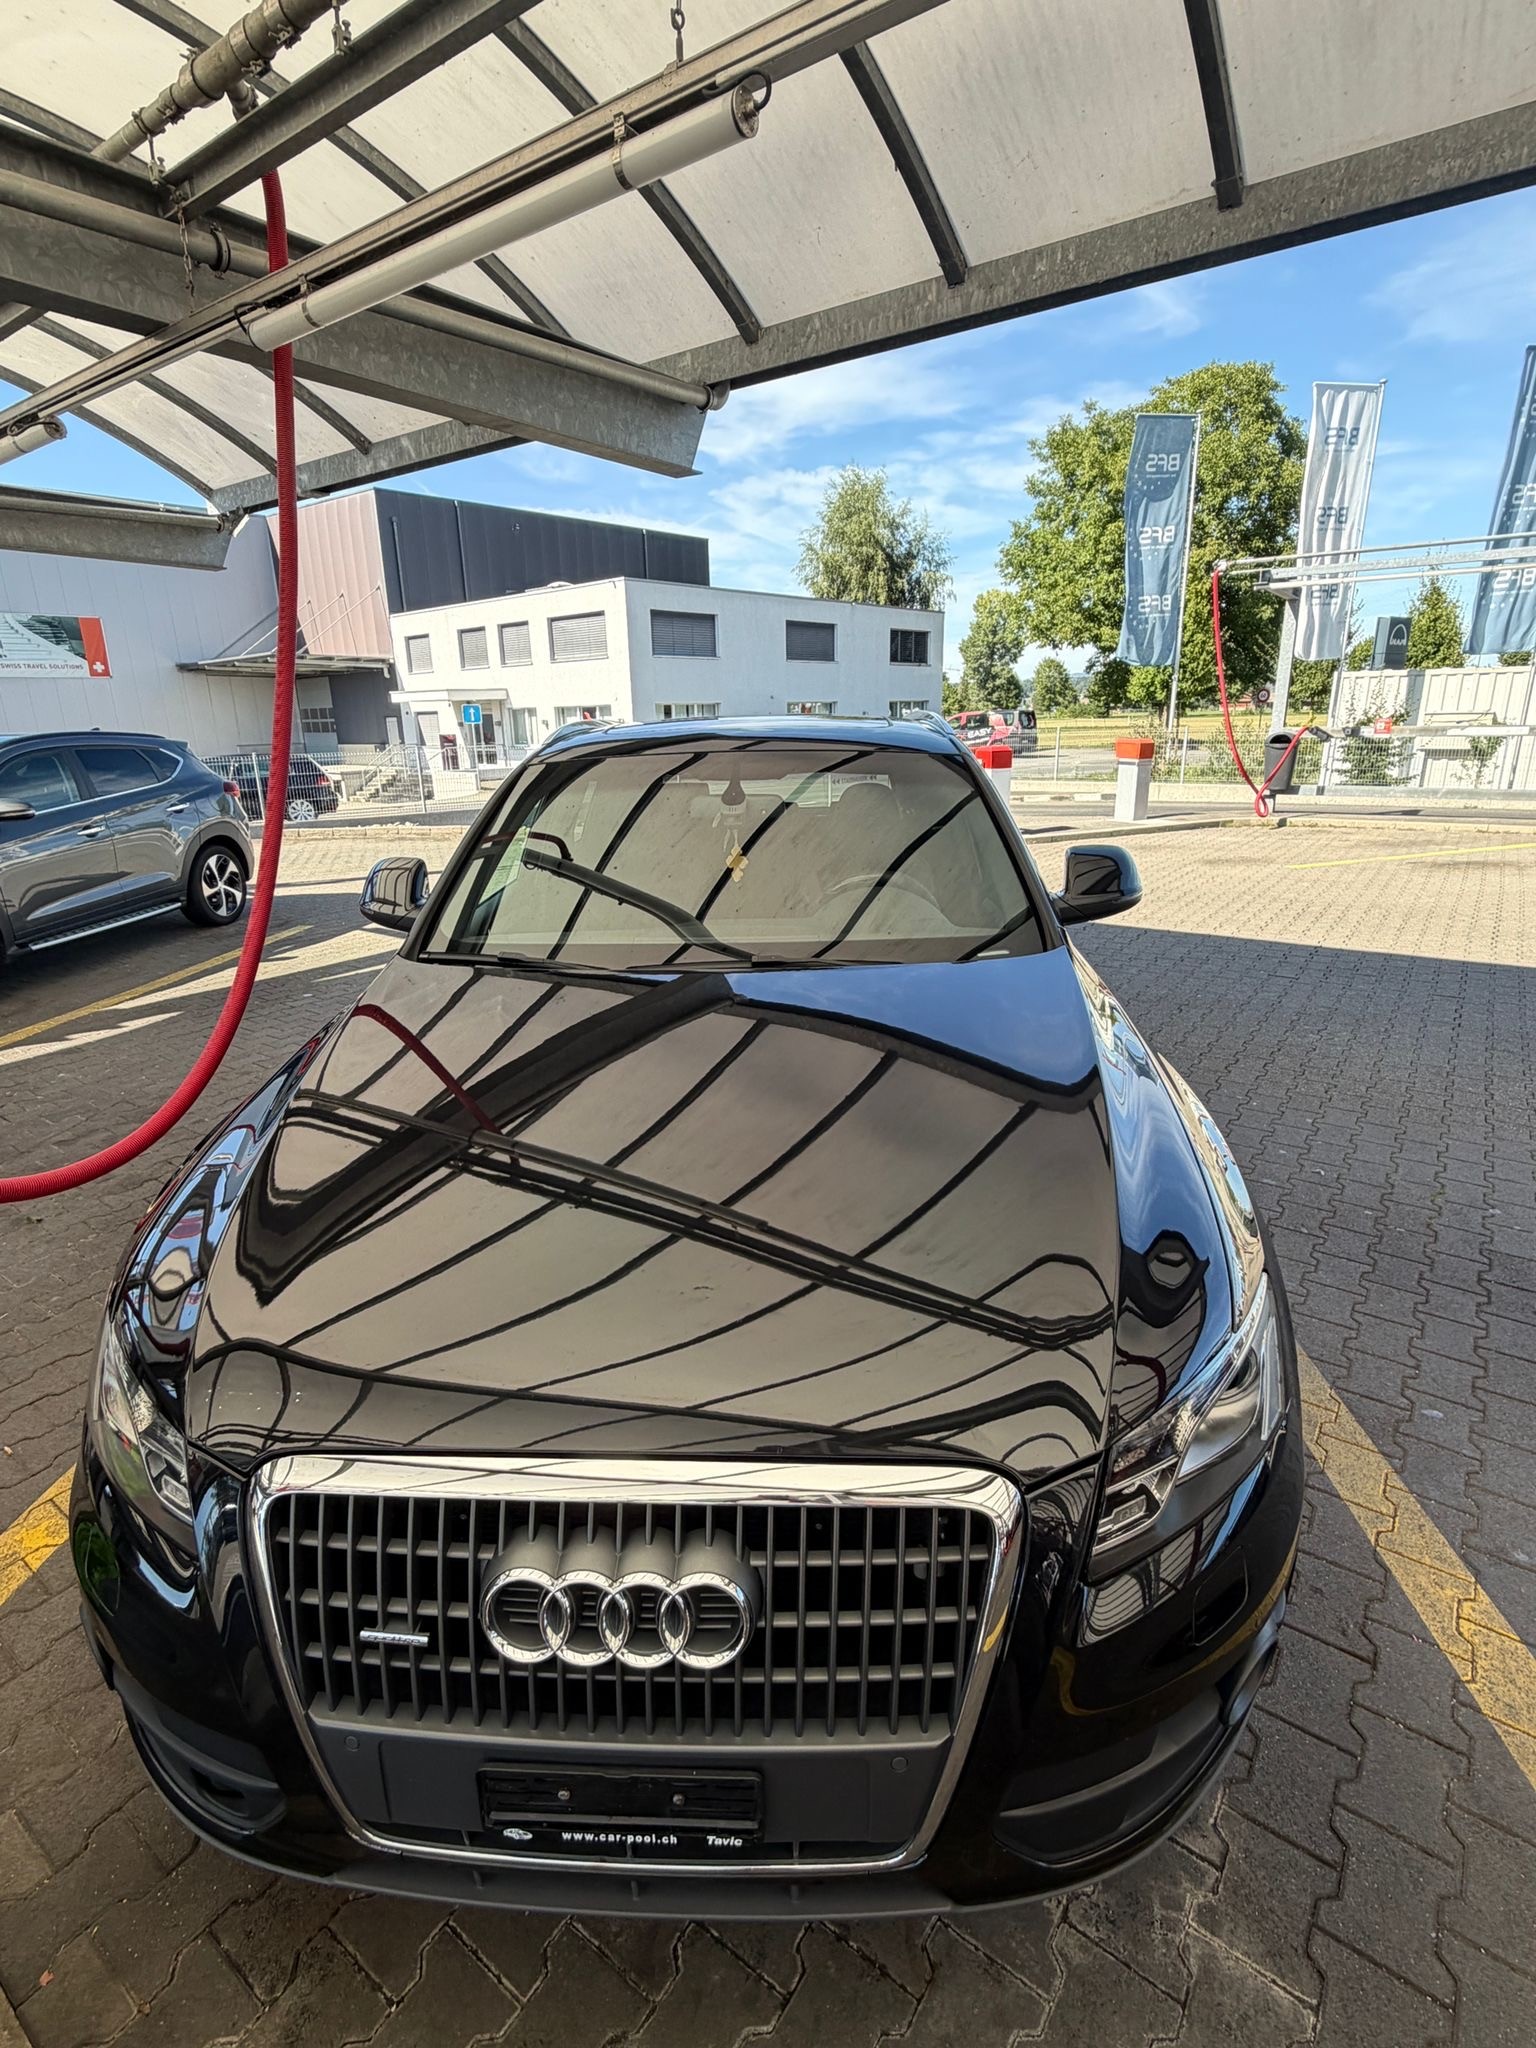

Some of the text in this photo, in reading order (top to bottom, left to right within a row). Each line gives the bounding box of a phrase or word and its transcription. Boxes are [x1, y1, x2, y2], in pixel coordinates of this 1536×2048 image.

[967, 728, 992, 738] EASY
[561, 1831, 743, 1847] www.car-pool.ch Tavic
